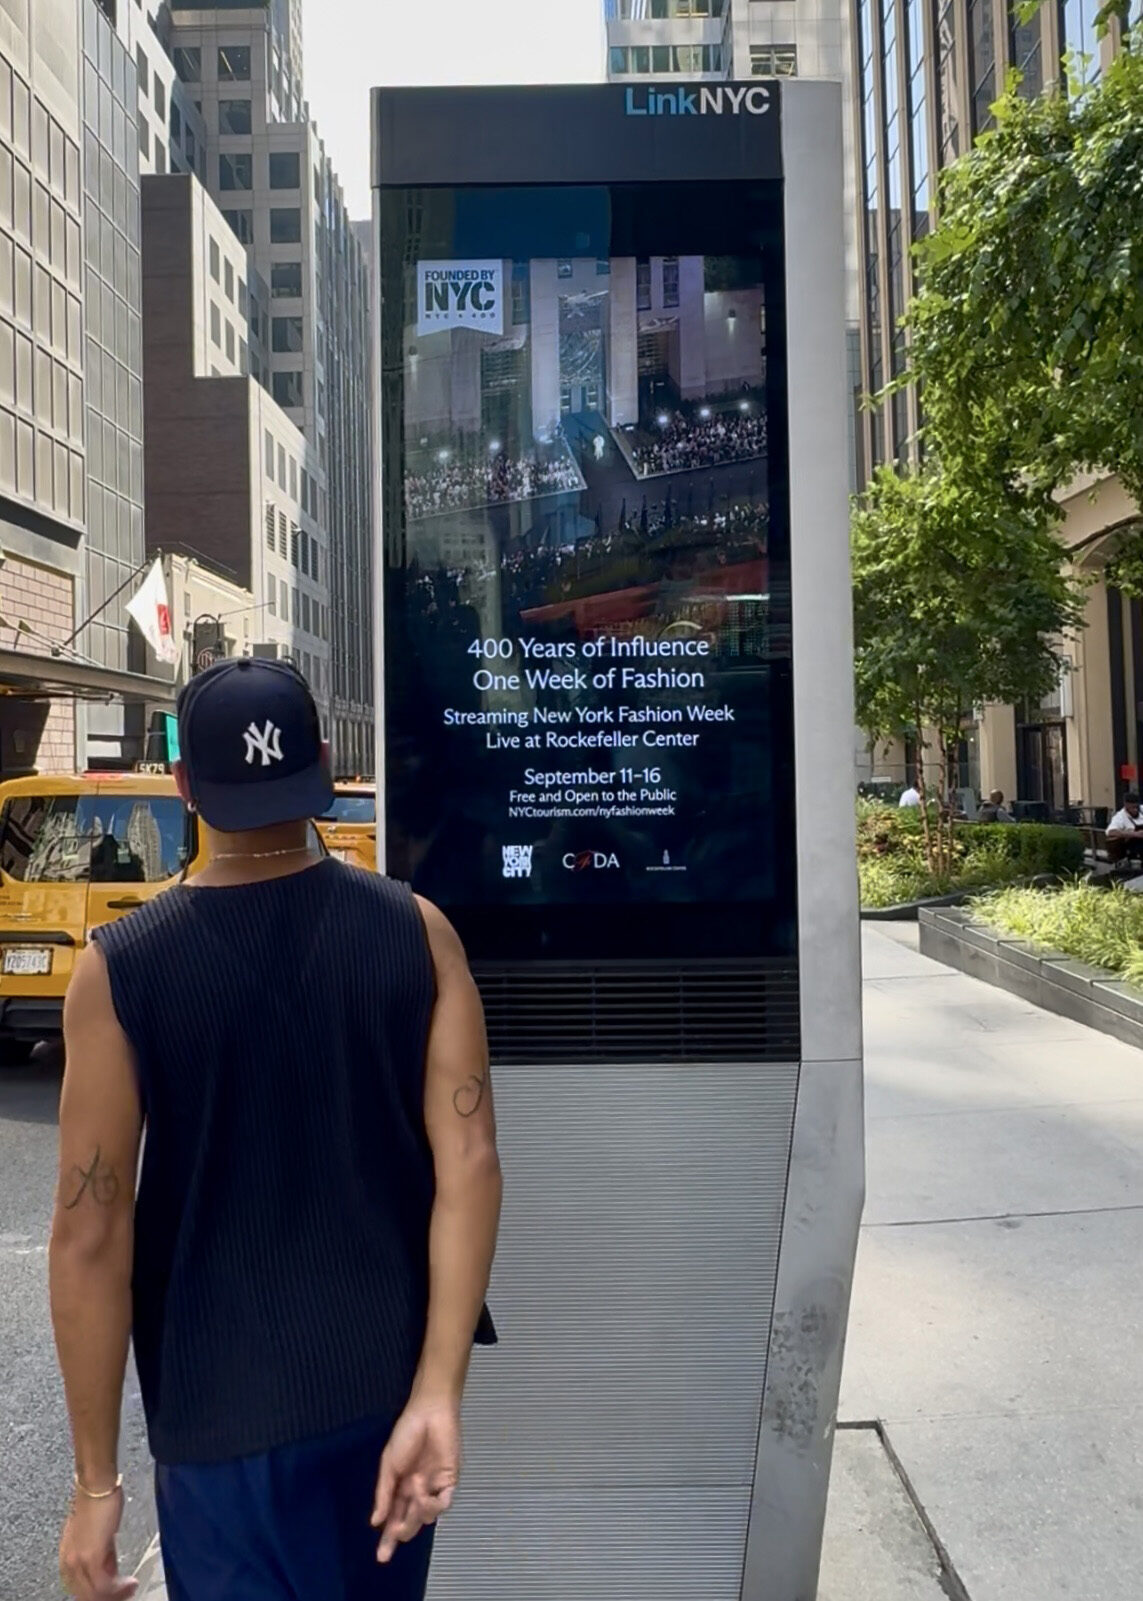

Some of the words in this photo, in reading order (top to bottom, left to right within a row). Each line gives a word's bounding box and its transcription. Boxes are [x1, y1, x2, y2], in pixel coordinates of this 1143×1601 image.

[625, 86, 770, 115] LinkNYC
[425, 270, 479, 281] FOUNDED
[480, 269, 495, 280] BY
[425, 281, 495, 311] NYC
[467, 638, 513, 658] 400
[518, 637, 576, 658] Years
[582, 636, 606, 658] of
[611, 635, 710, 657] Influence
[473, 669, 520, 690] One
[525, 668, 587, 690] Week
[593, 667, 616, 689] of
[622, 667, 705, 688] Fashion
[443, 707, 529, 728] Streaming
[533, 706, 572, 724] New
[575, 705, 614, 723] York
[619, 705, 683, 722] Fashion
[686, 704, 736, 722] Week
[486, 732, 521, 749] Live
[524, 733, 541, 749] at
[546, 730, 639, 748] Rockefeller
[642, 730, 700, 747] Center
[524, 767, 616, 788] September
[509, 789, 537, 802] Free
[538, 789, 562, 802] and
[564, 789, 599, 804] Open
[601, 790, 615, 802] to
[617, 788, 637, 801] the
[640, 787, 677, 801] Public
[508, 804, 676, 819] NYCtourism.com/nyfashionweek
[502, 865, 532, 878] CITY
